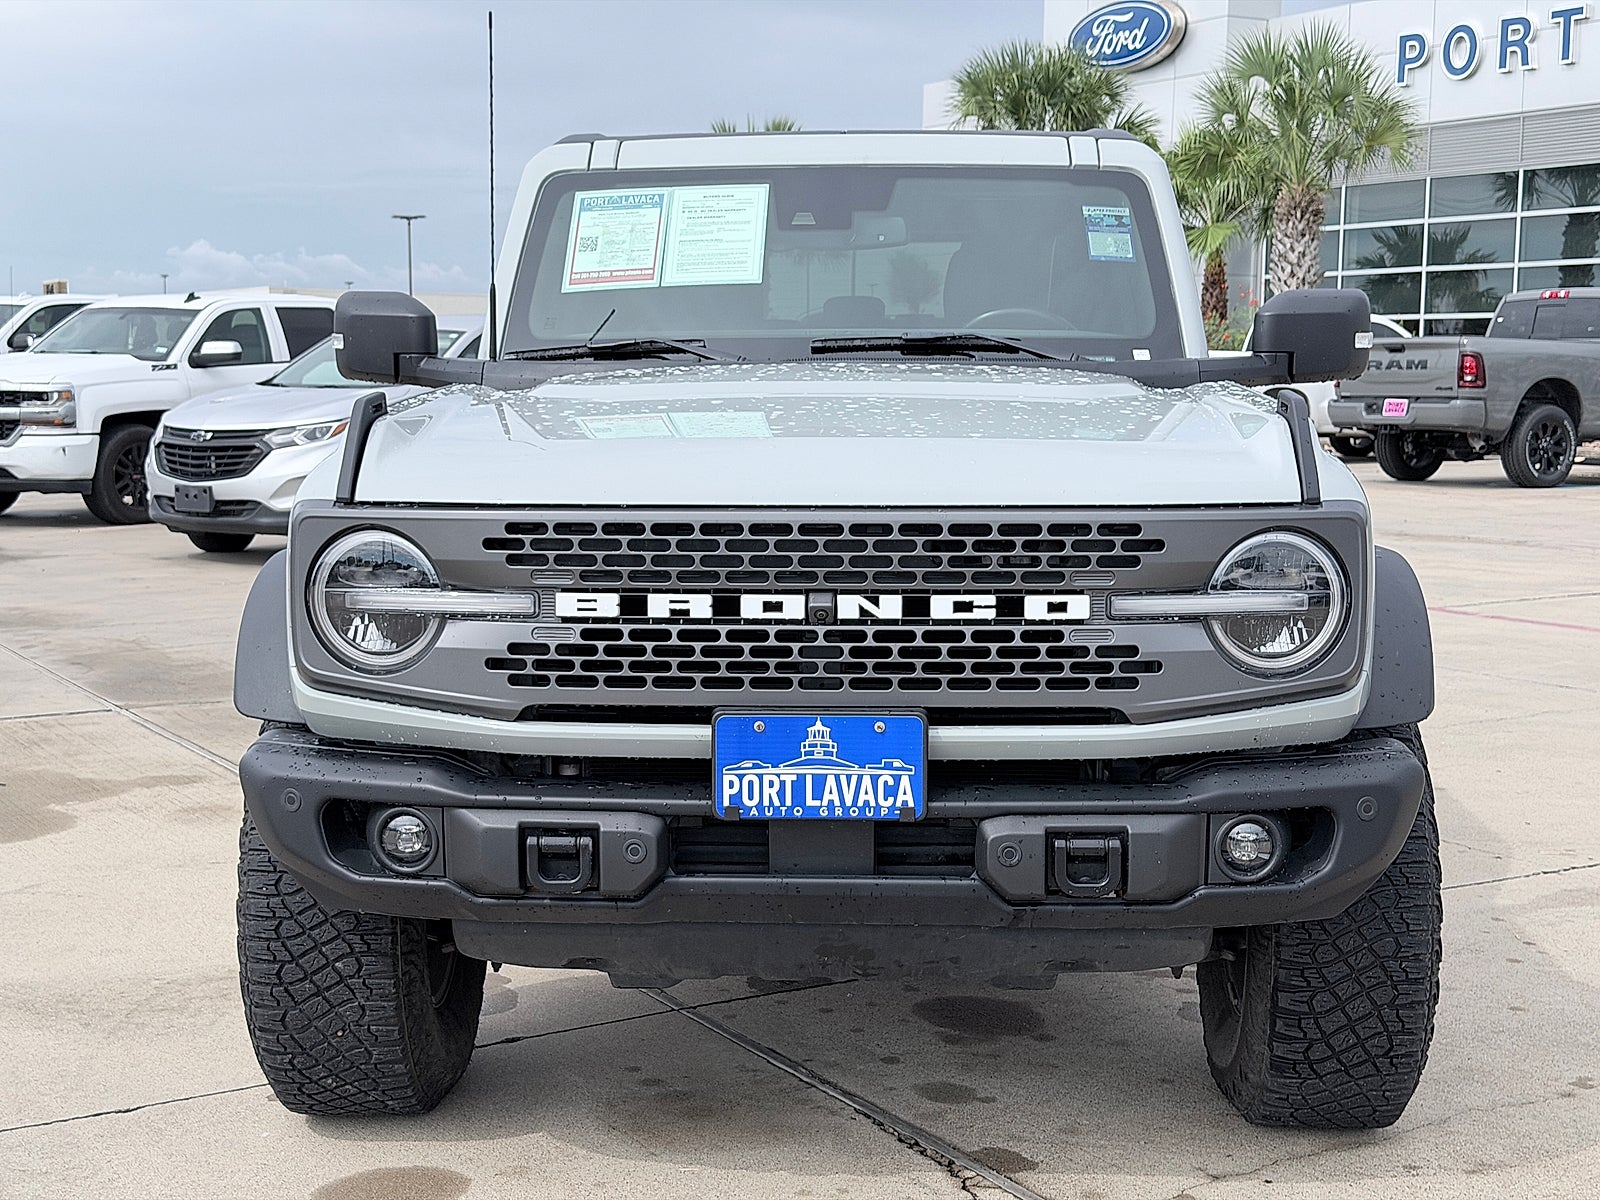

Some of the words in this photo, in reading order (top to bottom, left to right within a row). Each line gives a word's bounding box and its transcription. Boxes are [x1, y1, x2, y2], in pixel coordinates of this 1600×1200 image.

[1085, 11, 1149, 57] Ford
[1398, 4, 1589, 86] PORT
[583, 197, 610, 207] PORT
[621, 194, 660, 205] LAVACA
[1367, 359, 1428, 371] RAM
[555, 593, 1090, 618] BRONCO
[722, 774, 797, 807] PORT
[805, 774, 914, 807] LAVACA
[750, 807, 803, 816] AUTO
[819, 807, 888, 816] GROUP
